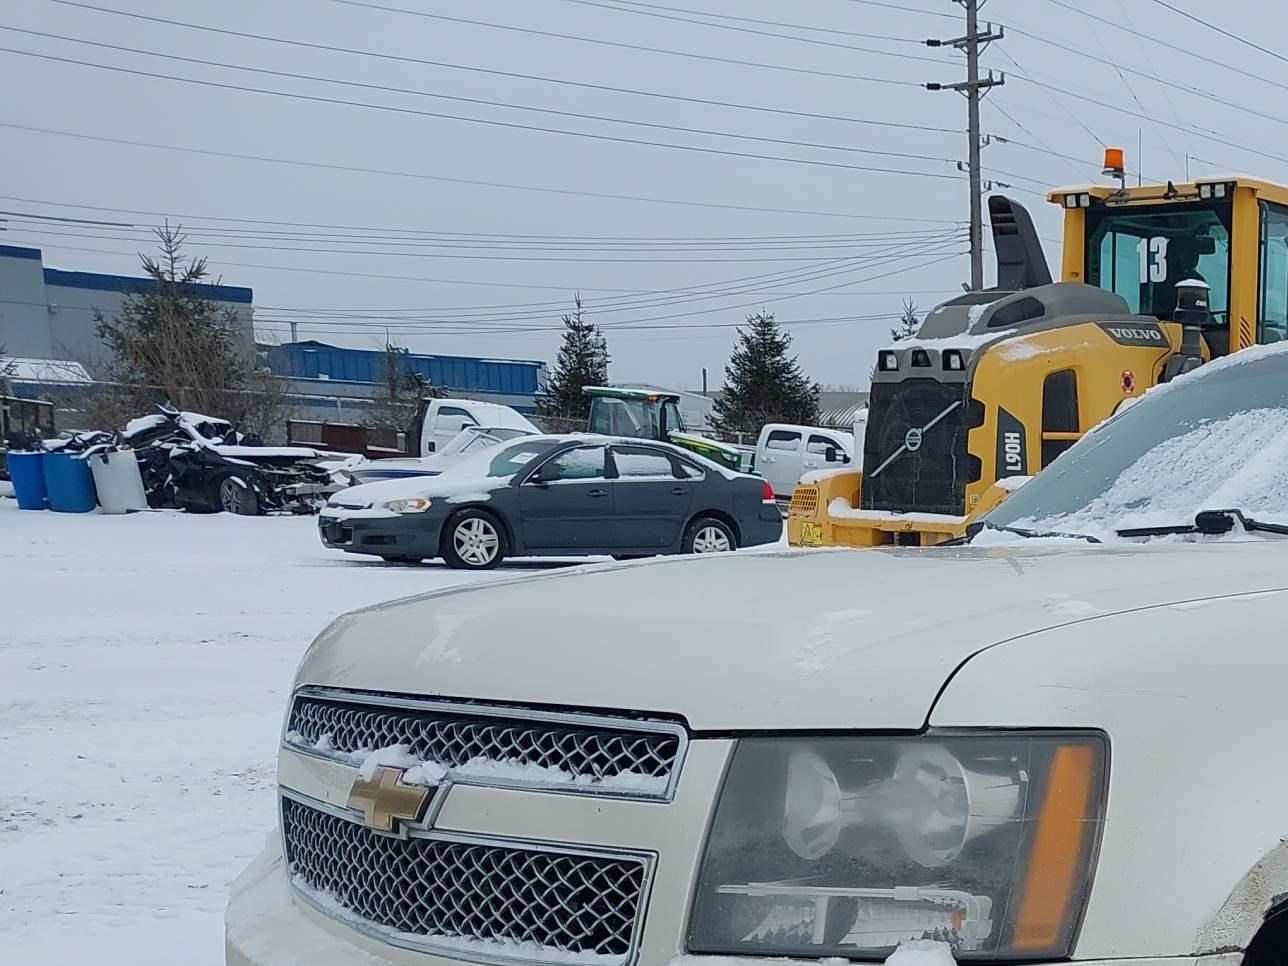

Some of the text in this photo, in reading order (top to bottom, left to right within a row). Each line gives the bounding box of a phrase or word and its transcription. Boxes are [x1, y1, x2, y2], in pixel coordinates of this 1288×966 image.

[1136, 236, 1169, 283] 13
[1107, 328, 1161, 340] VOLVO
[1004, 432, 1022, 471] L90H
